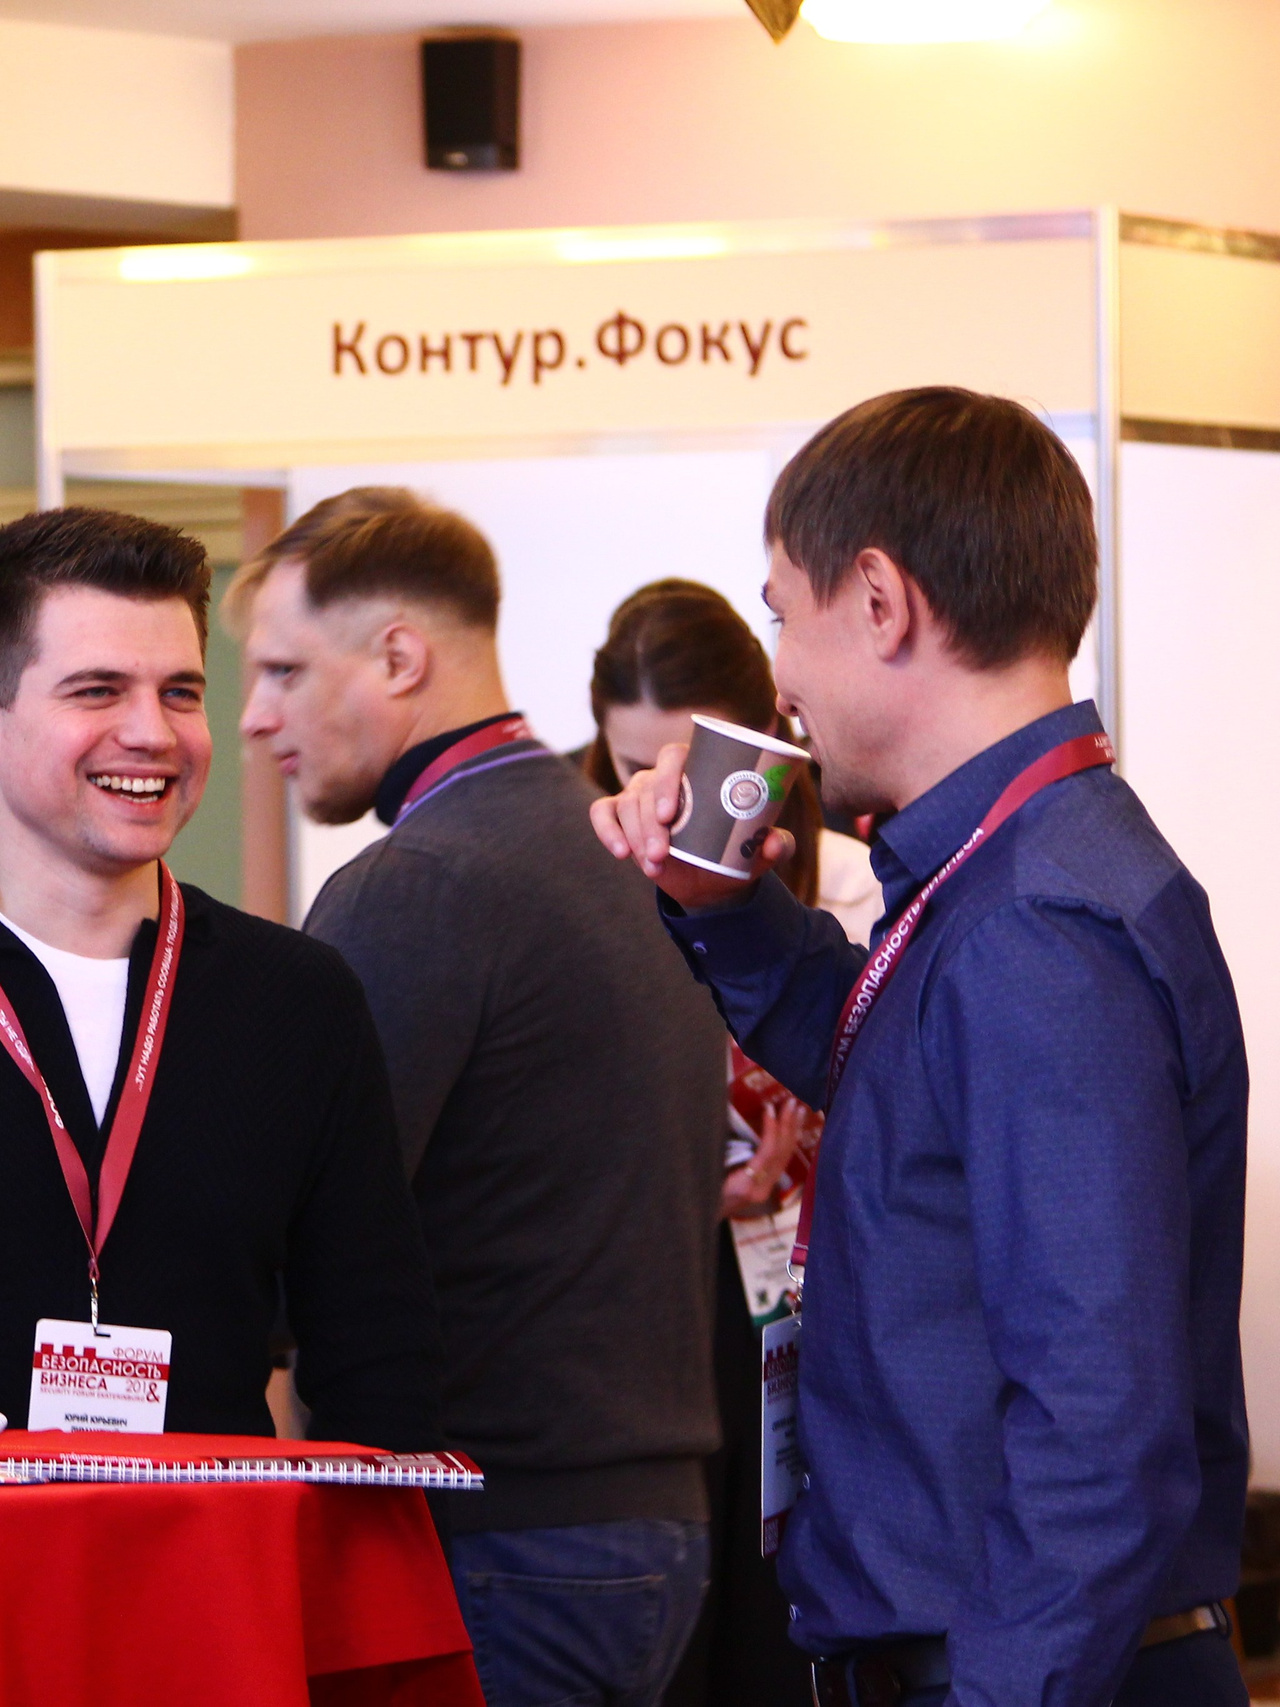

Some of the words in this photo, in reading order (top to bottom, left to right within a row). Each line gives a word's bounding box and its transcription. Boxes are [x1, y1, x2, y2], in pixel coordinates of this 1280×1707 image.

[331, 309, 809, 386] Контур.Фокус
[843, 903, 921, 1036] БЕЗОПАСНОСТЬ
[146, 988, 165, 1037] РАБОТАТЬ
[140, 1034, 154, 1066] НАДО
[41, 1353, 162, 1379] БЕЗОПАСНОСТЬ
[113, 1347, 164, 1363] ФОРУМ
[40, 1371, 108, 1391] БИЗНЕСА
